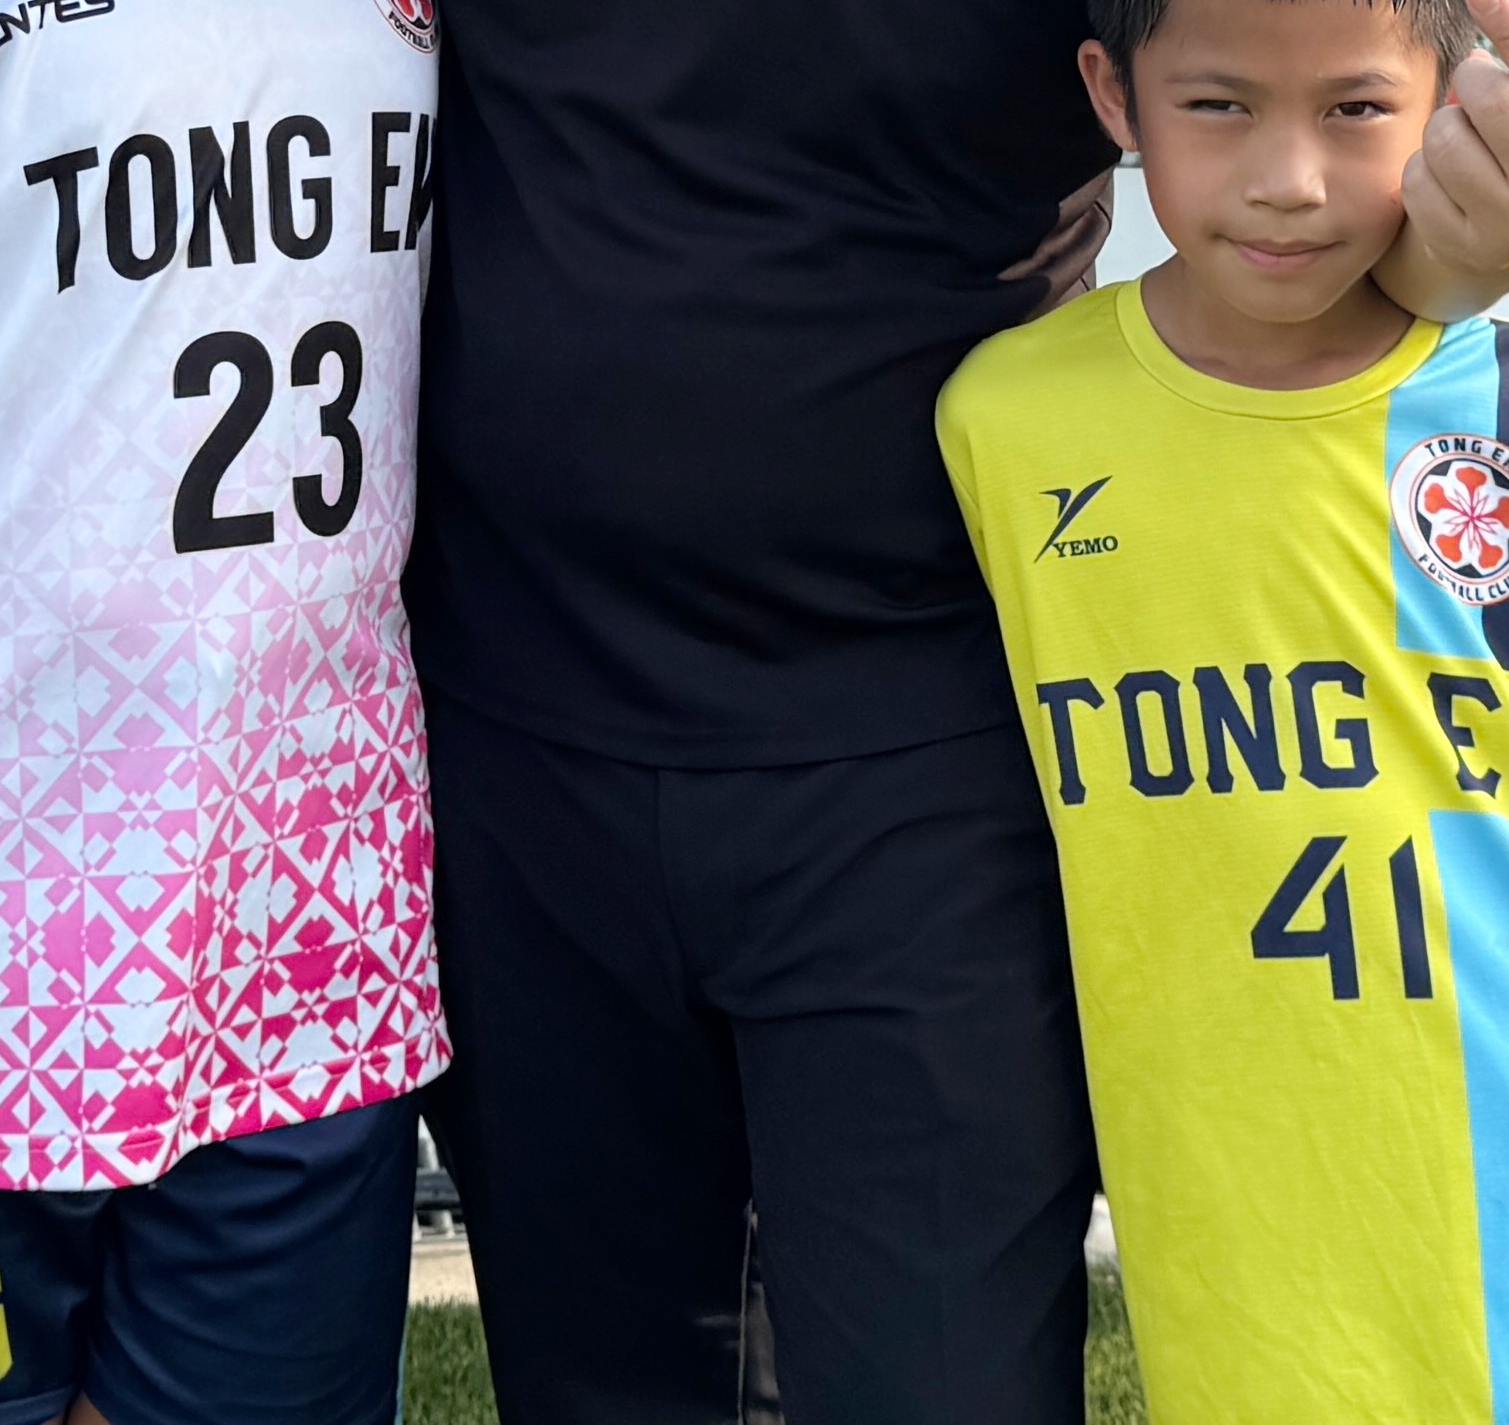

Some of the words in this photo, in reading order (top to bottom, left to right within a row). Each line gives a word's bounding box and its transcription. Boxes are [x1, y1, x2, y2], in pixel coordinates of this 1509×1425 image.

[23, 114, 334, 295] TONG
[172, 320, 363, 555] 23
[1424, 437, 1483, 458] TONG
[1052, 534, 1119, 559] YEMO
[1036, 660, 1380, 806] TONG
[1250, 833, 1434, 1000] 41
